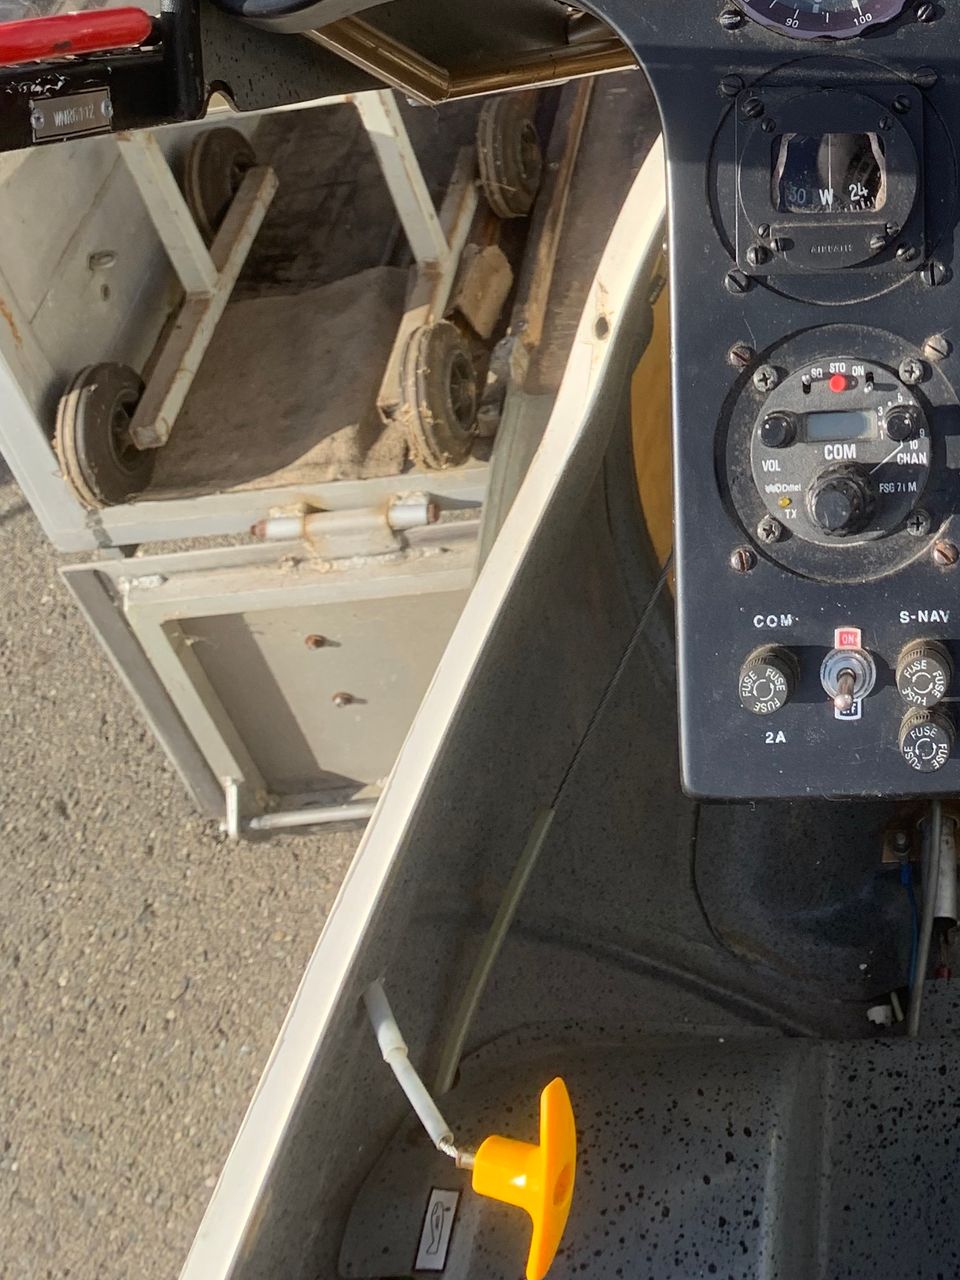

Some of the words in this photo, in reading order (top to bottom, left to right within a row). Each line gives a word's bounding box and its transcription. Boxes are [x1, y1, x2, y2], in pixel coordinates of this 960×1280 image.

[785, 18, 800, 29] 90
[853, 13, 873, 27] 100
[788, 185, 806, 204] 30
[818, 188, 834, 205] W
[848, 182, 869, 201] 24
[811, 368, 823, 378] SQ
[829, 362, 846, 373] STO
[852, 366, 865, 376] ON
[897, 392, 903, 403] 5
[878, 406, 884, 417] 3
[880, 430, 884, 440] 1
[919, 428, 925, 439] 9
[909, 439, 919, 450] 10
[824, 444, 856, 461] COM
[896, 452, 928, 465] CHAN
[761, 460, 781, 472] VOL
[879, 482, 895, 494] FSG
[908, 481, 917, 492] M
[784, 509, 798, 519] TX
[753, 613, 793, 628] COM
[899, 609, 950, 624] S-NAV
[841, 633, 855, 645] ON
[903, 659, 927, 679] FUSE
[742, 670, 757, 697] FUSE
[765, 667, 785, 692] FUSE
[931, 670, 945, 699] FUSE
[901, 686, 928, 706] FUSE
[753, 697, 781, 713] FUSE
[765, 731, 787, 744] 2A
[910, 726, 938, 740] FUSE
[903, 746, 922, 770] FUSE
[931, 743, 948, 770] FUSE
